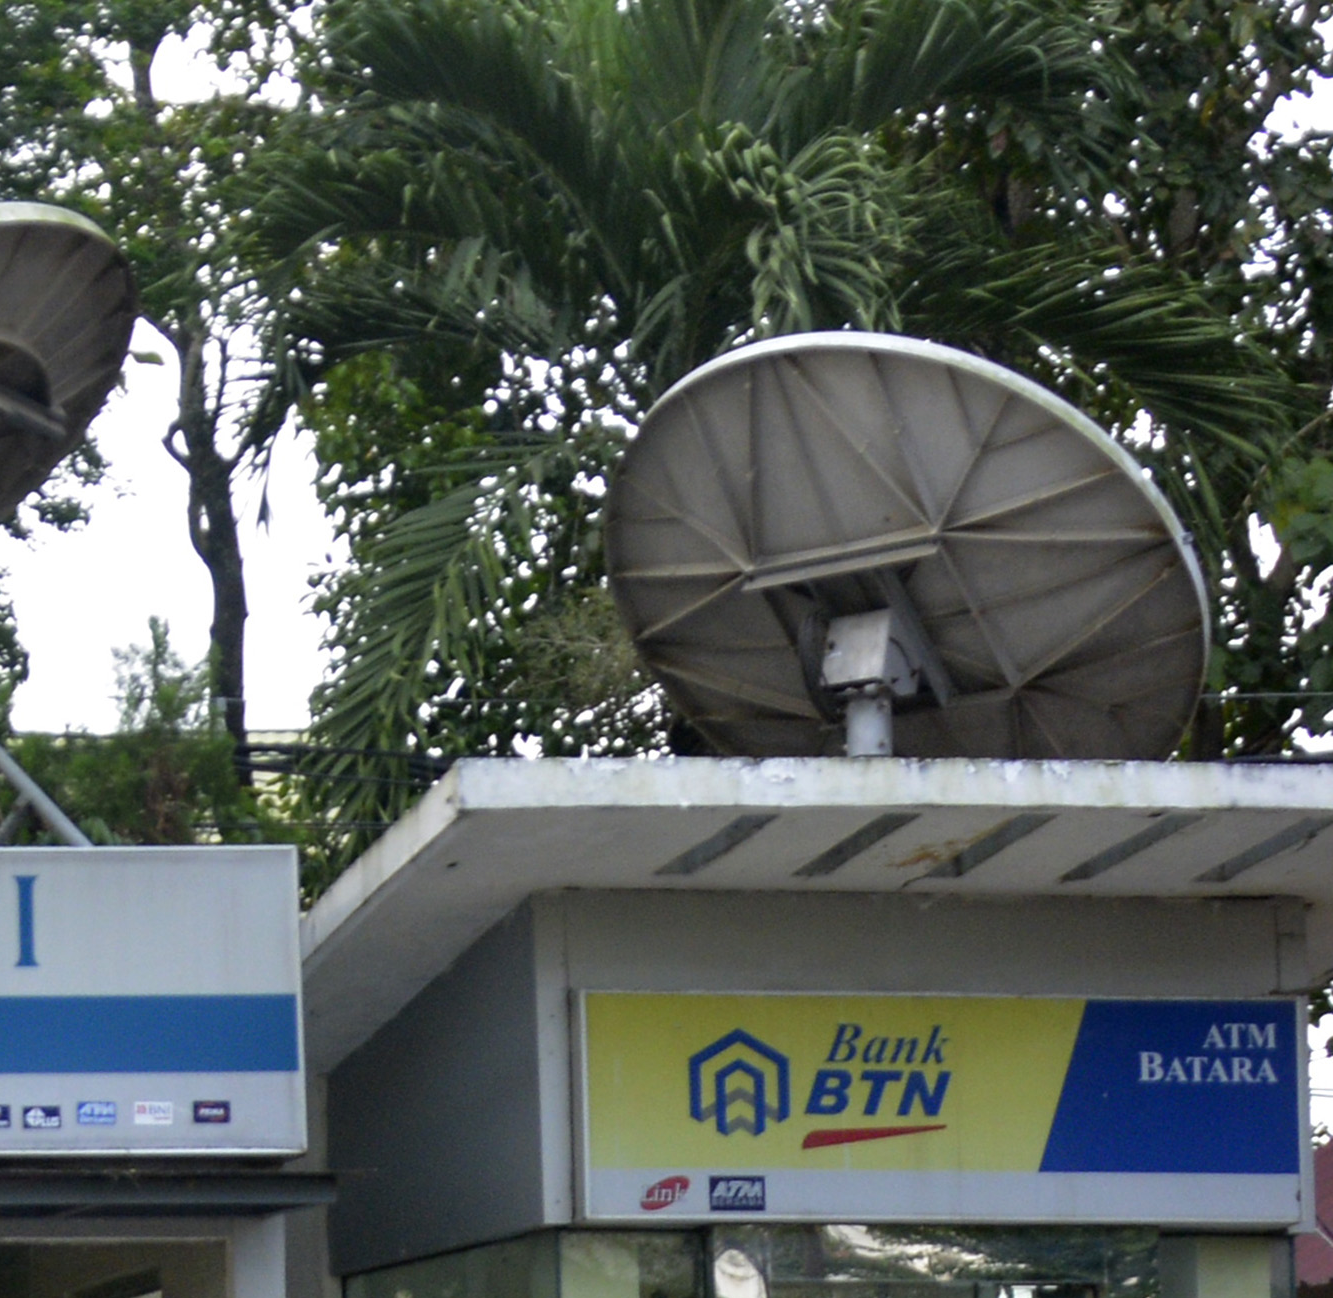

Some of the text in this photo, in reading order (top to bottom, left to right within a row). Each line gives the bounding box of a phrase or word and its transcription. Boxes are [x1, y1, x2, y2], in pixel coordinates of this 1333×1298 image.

[825, 1023, 950, 1064] Bank
[1202, 1023, 1277, 1049] ATM
[1139, 1051, 1278, 1083] BATARA
[805, 1069, 952, 1116] BTN
[641, 1181, 687, 1202] Link
[712, 1180, 764, 1197] ATM
